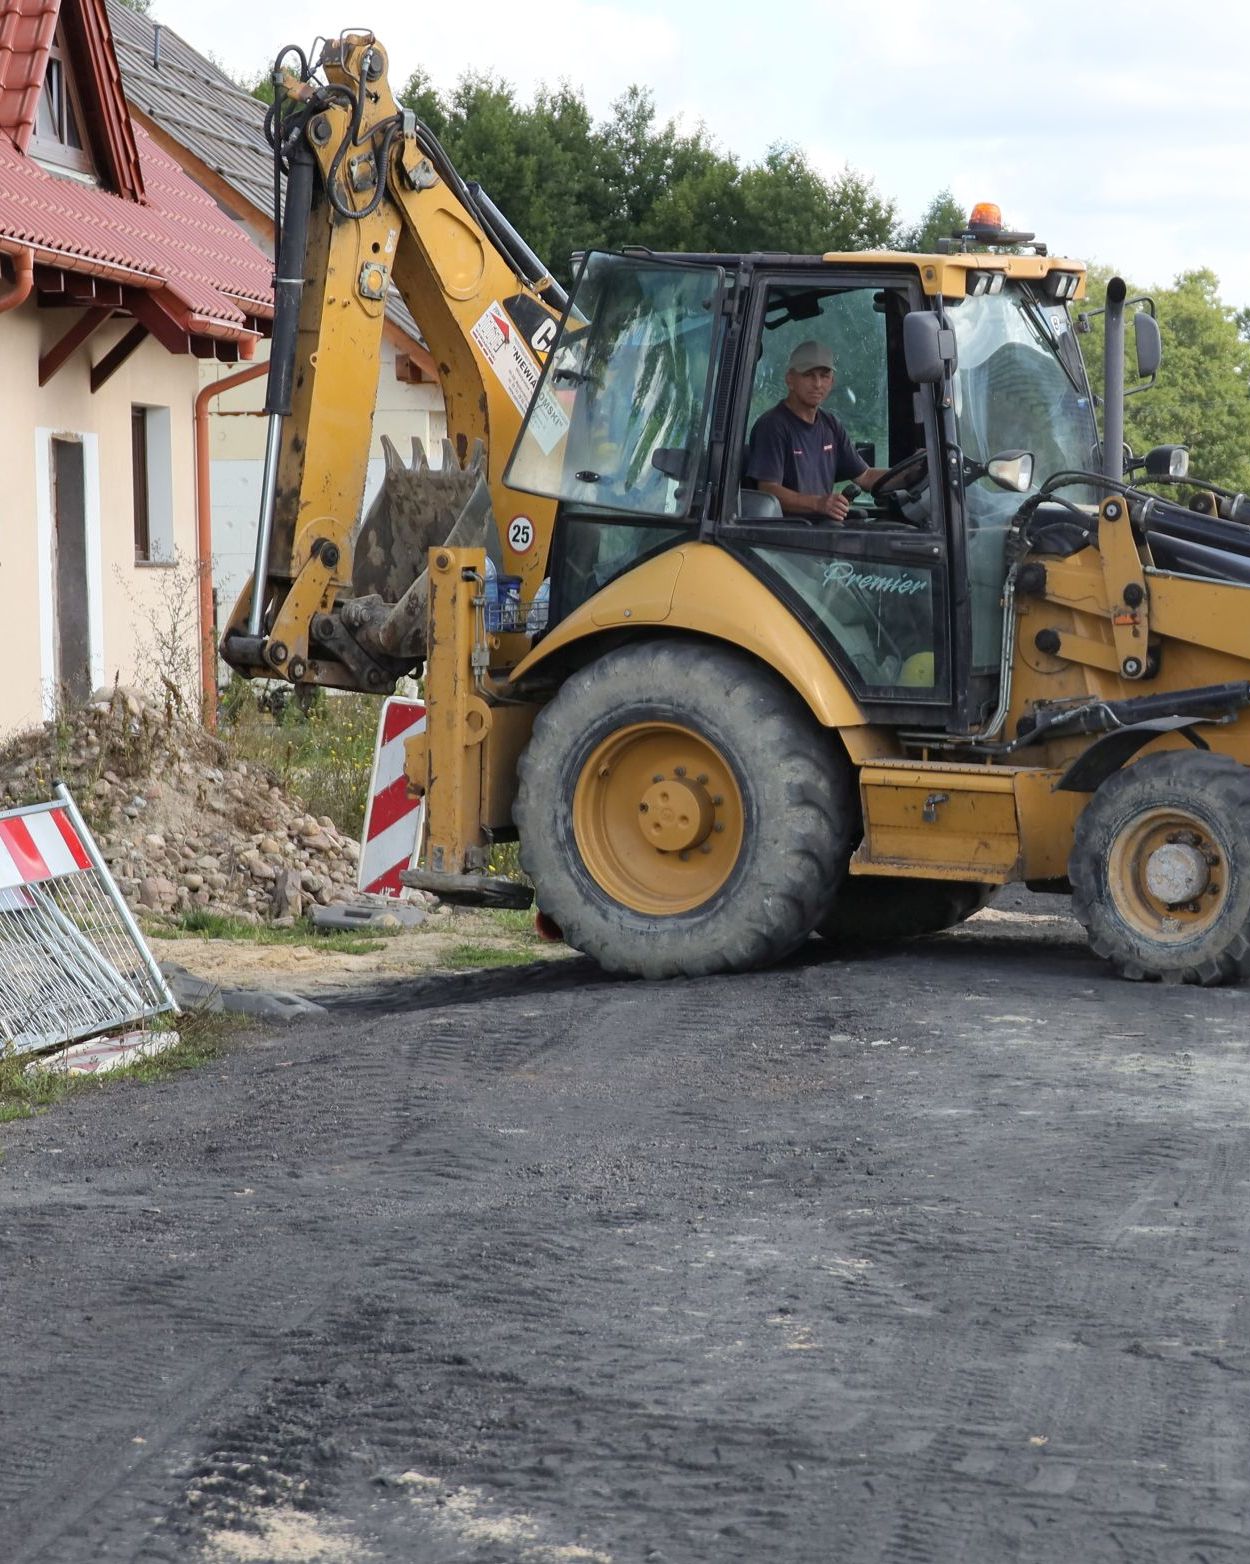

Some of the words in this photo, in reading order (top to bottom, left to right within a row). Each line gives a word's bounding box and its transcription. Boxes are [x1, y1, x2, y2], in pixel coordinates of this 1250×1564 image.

[512, 345, 564, 427] "NIEWIAOMSKI"
[511, 524, 530, 544] 25
[822, 561, 928, 595] Premier
